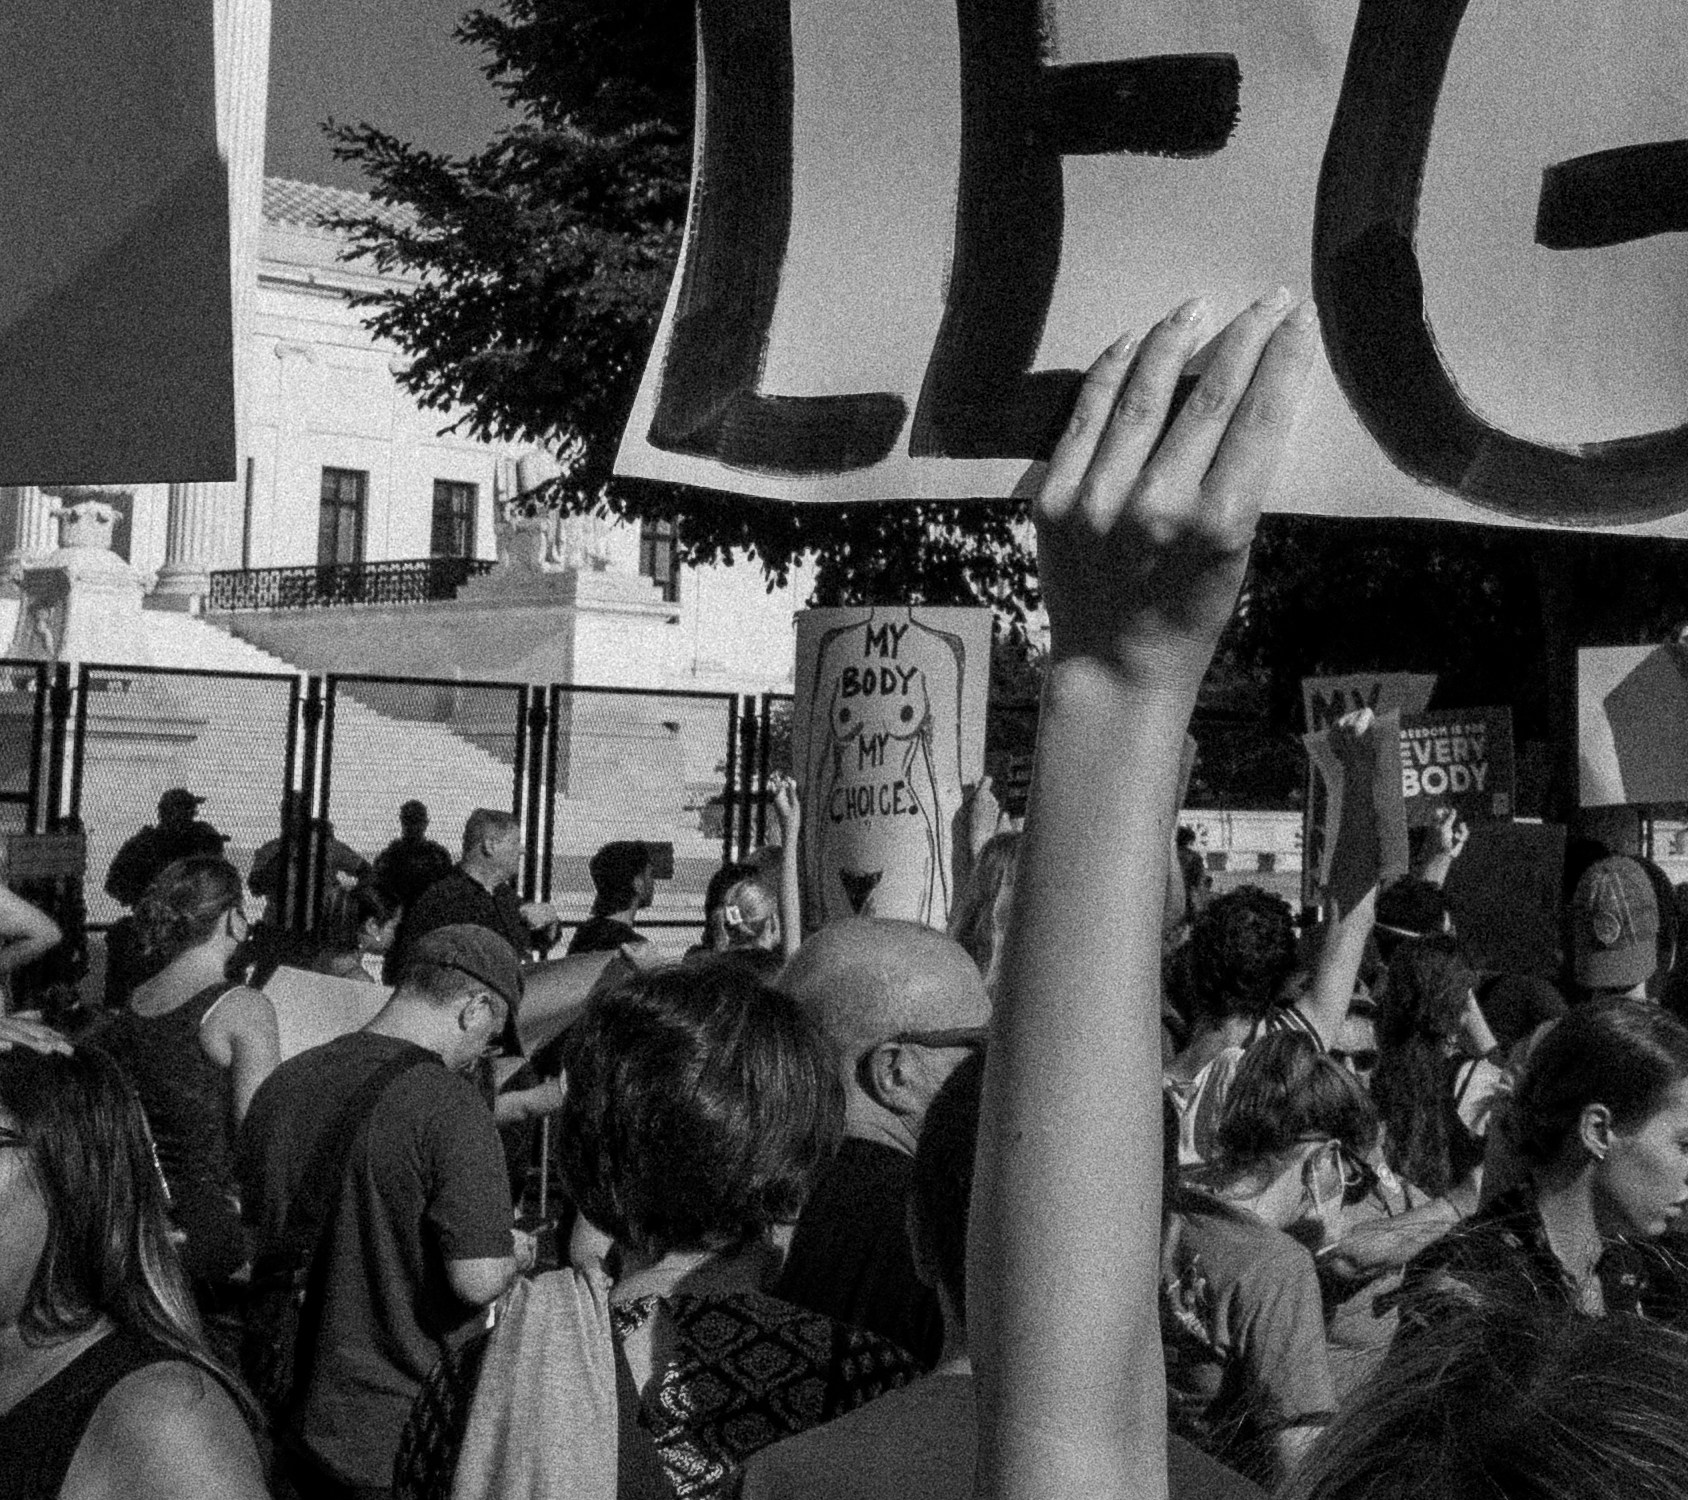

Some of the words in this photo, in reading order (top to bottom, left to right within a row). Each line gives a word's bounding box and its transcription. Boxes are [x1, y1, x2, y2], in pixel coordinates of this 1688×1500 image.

[865, 623, 908, 659] MY
[841, 666, 919, 697] BODY
[1400, 726, 1447, 740] REEDOM
[858, 733, 889, 771] MY
[1400, 737, 1486, 767] EVERY
[1402, 762, 1488, 798] BODY
